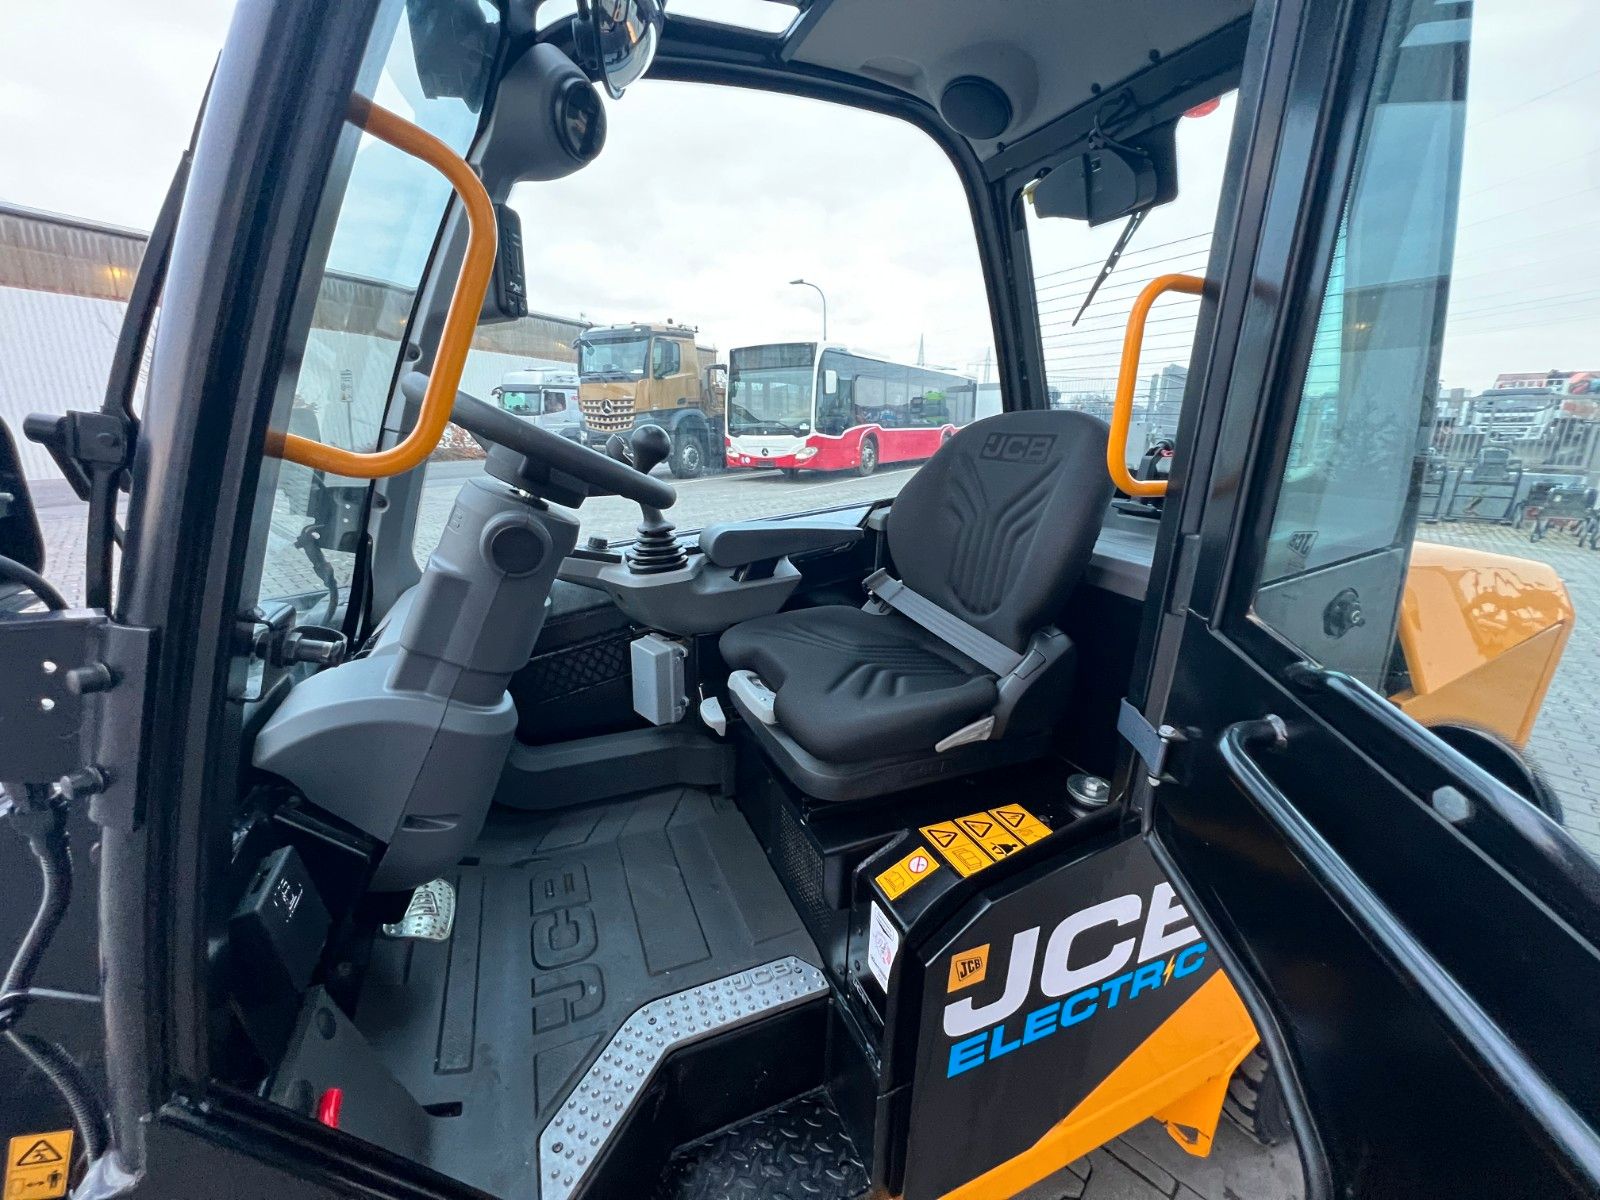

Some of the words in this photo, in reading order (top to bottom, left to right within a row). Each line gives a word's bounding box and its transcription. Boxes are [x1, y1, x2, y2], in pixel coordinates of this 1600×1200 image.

[982, 433, 1055, 462] JCB
[530, 863, 606, 1035] JCB
[731, 962, 792, 992] JCB
[959, 957, 982, 979] JCB
